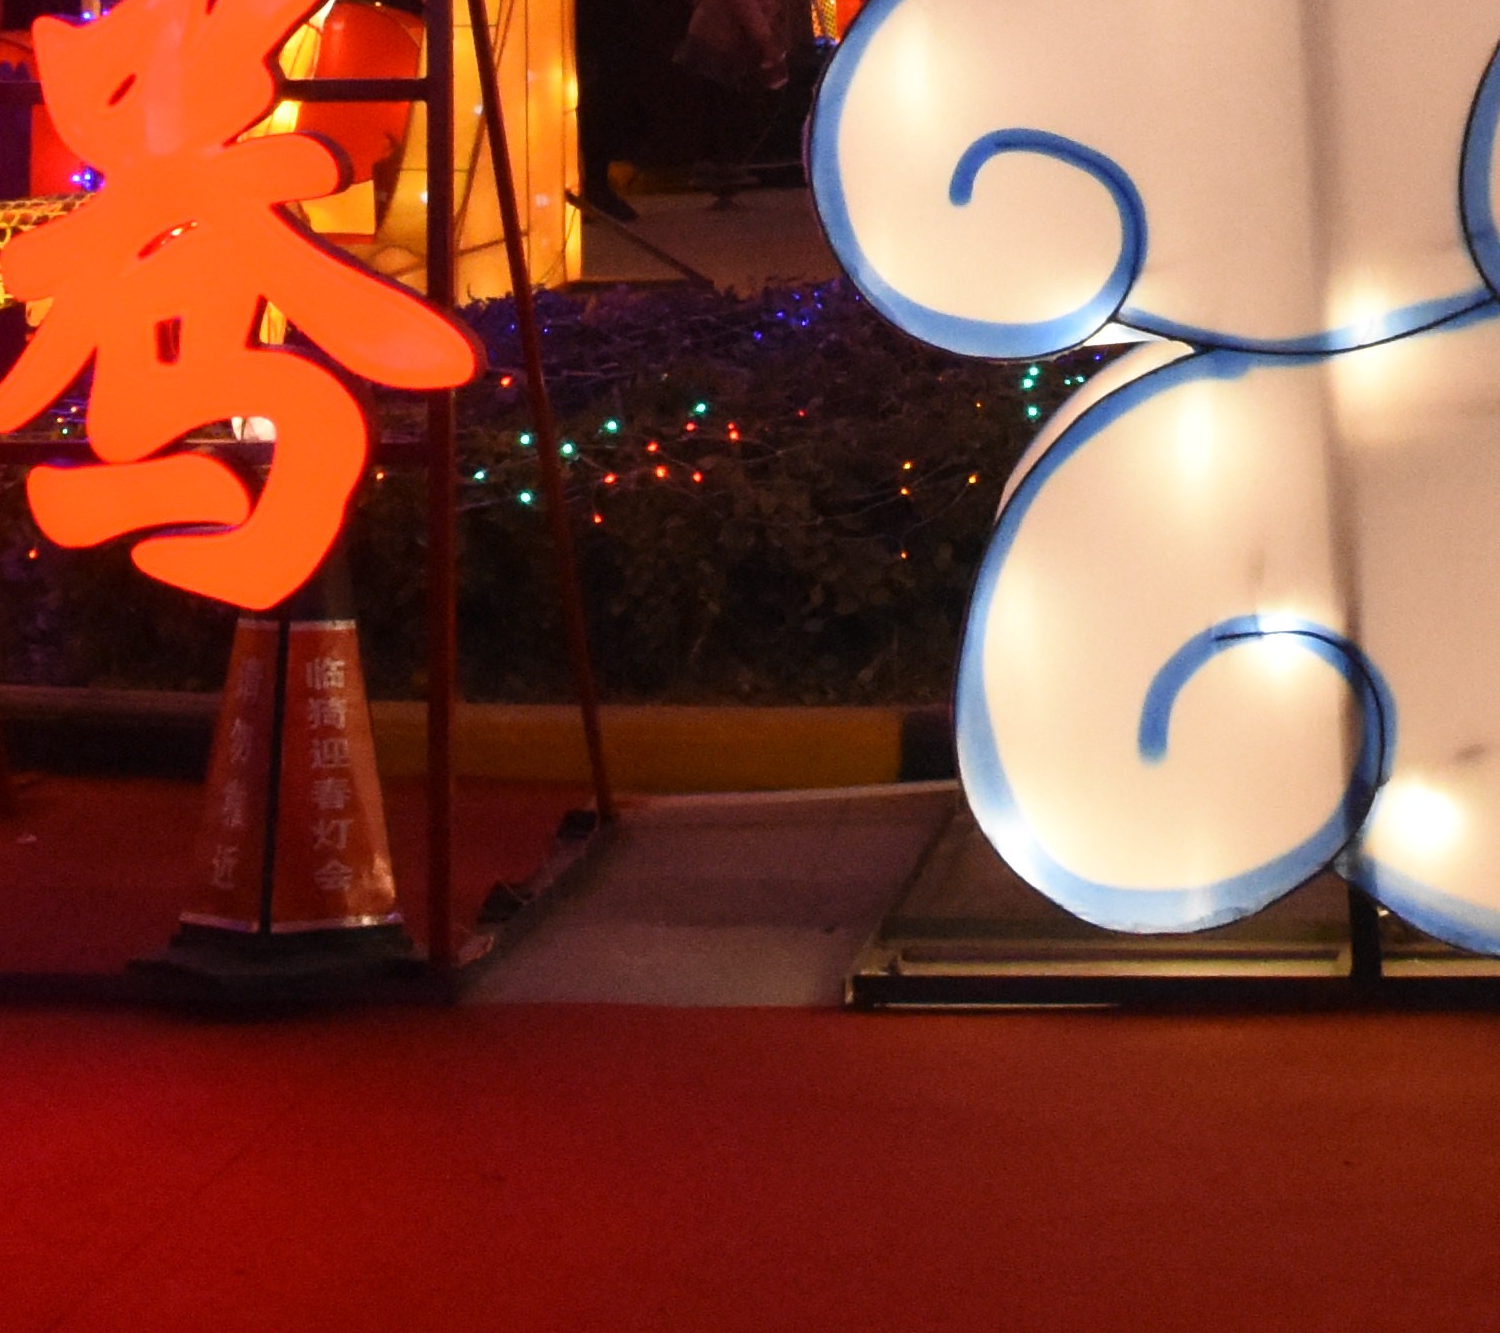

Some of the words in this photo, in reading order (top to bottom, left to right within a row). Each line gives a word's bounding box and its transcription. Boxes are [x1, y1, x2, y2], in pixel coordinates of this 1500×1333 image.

[305, 655, 354, 893] 临猗迎春灯会
